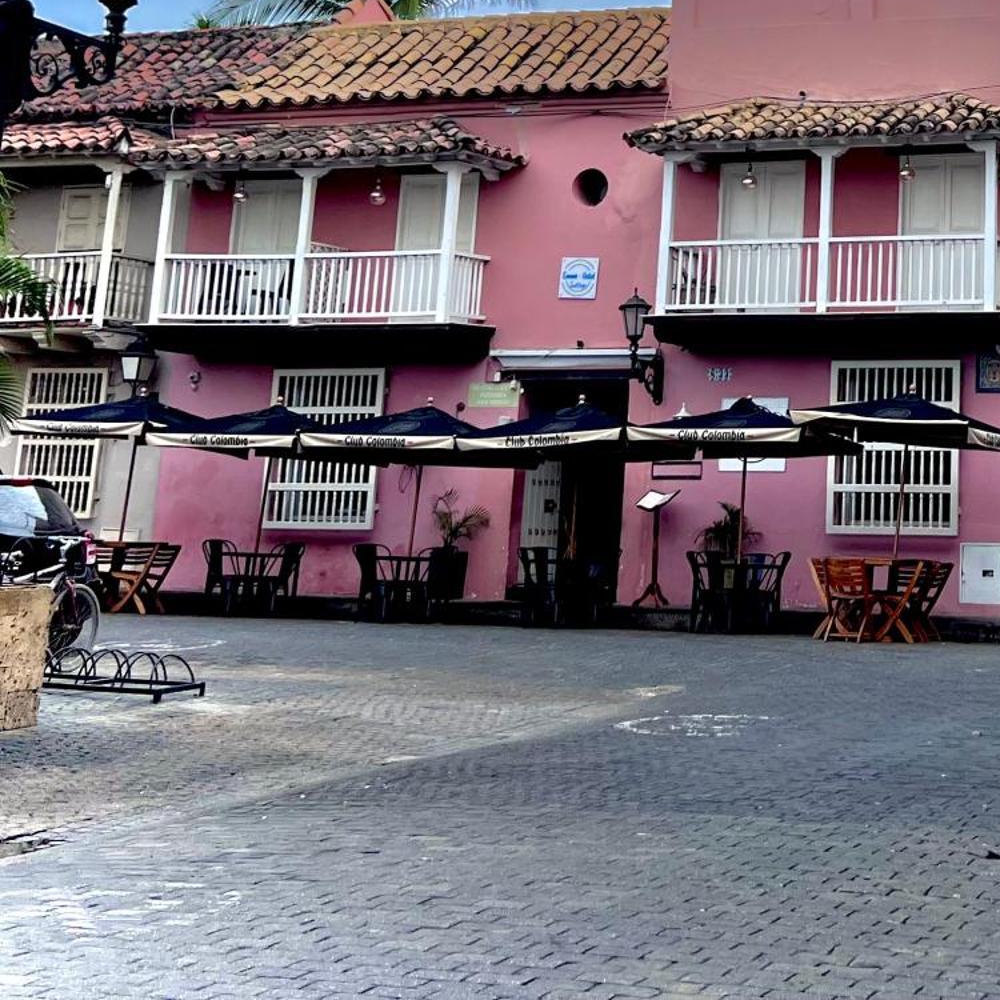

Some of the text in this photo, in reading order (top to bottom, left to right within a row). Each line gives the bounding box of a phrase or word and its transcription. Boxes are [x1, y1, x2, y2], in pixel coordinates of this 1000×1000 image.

[505, 434, 569, 447] Club Colombia
[678, 429, 745, 440] Club Colombia
[344, 435, 405, 447] Club Colombia
